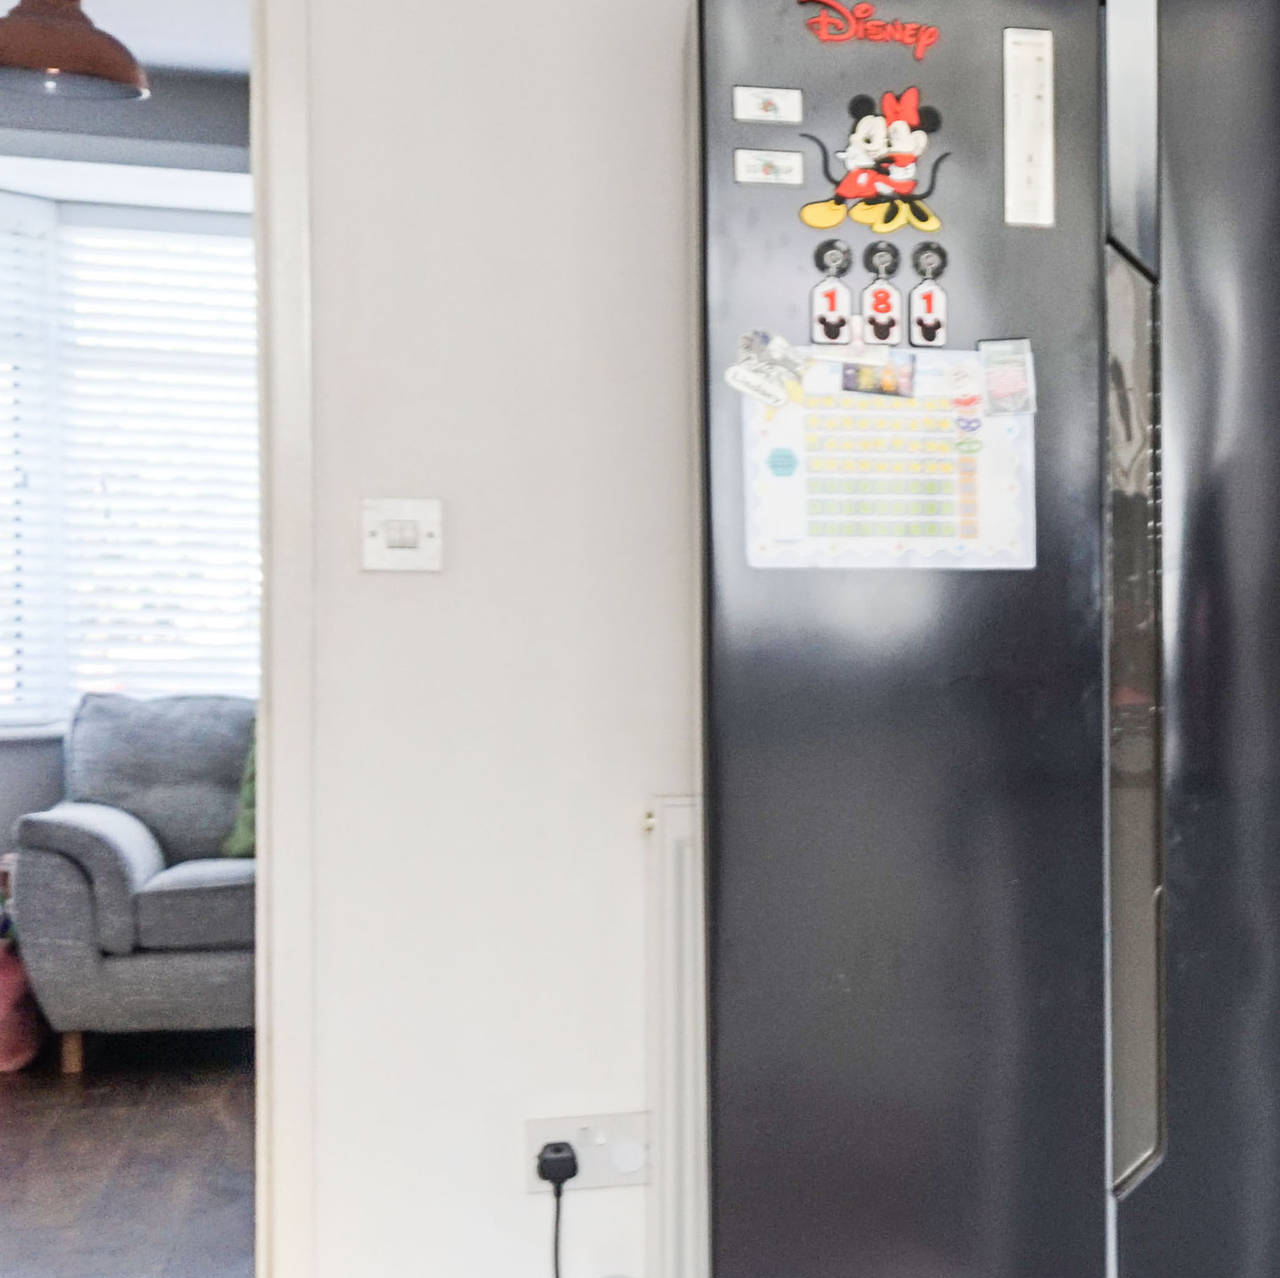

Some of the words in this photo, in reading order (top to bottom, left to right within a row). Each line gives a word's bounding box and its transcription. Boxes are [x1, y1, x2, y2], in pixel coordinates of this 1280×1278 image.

[797, 0, 941, 61] Disney
[821, 289, 838, 313] 1
[871, 288, 893, 314] 8
[920, 292, 935, 314] 1
